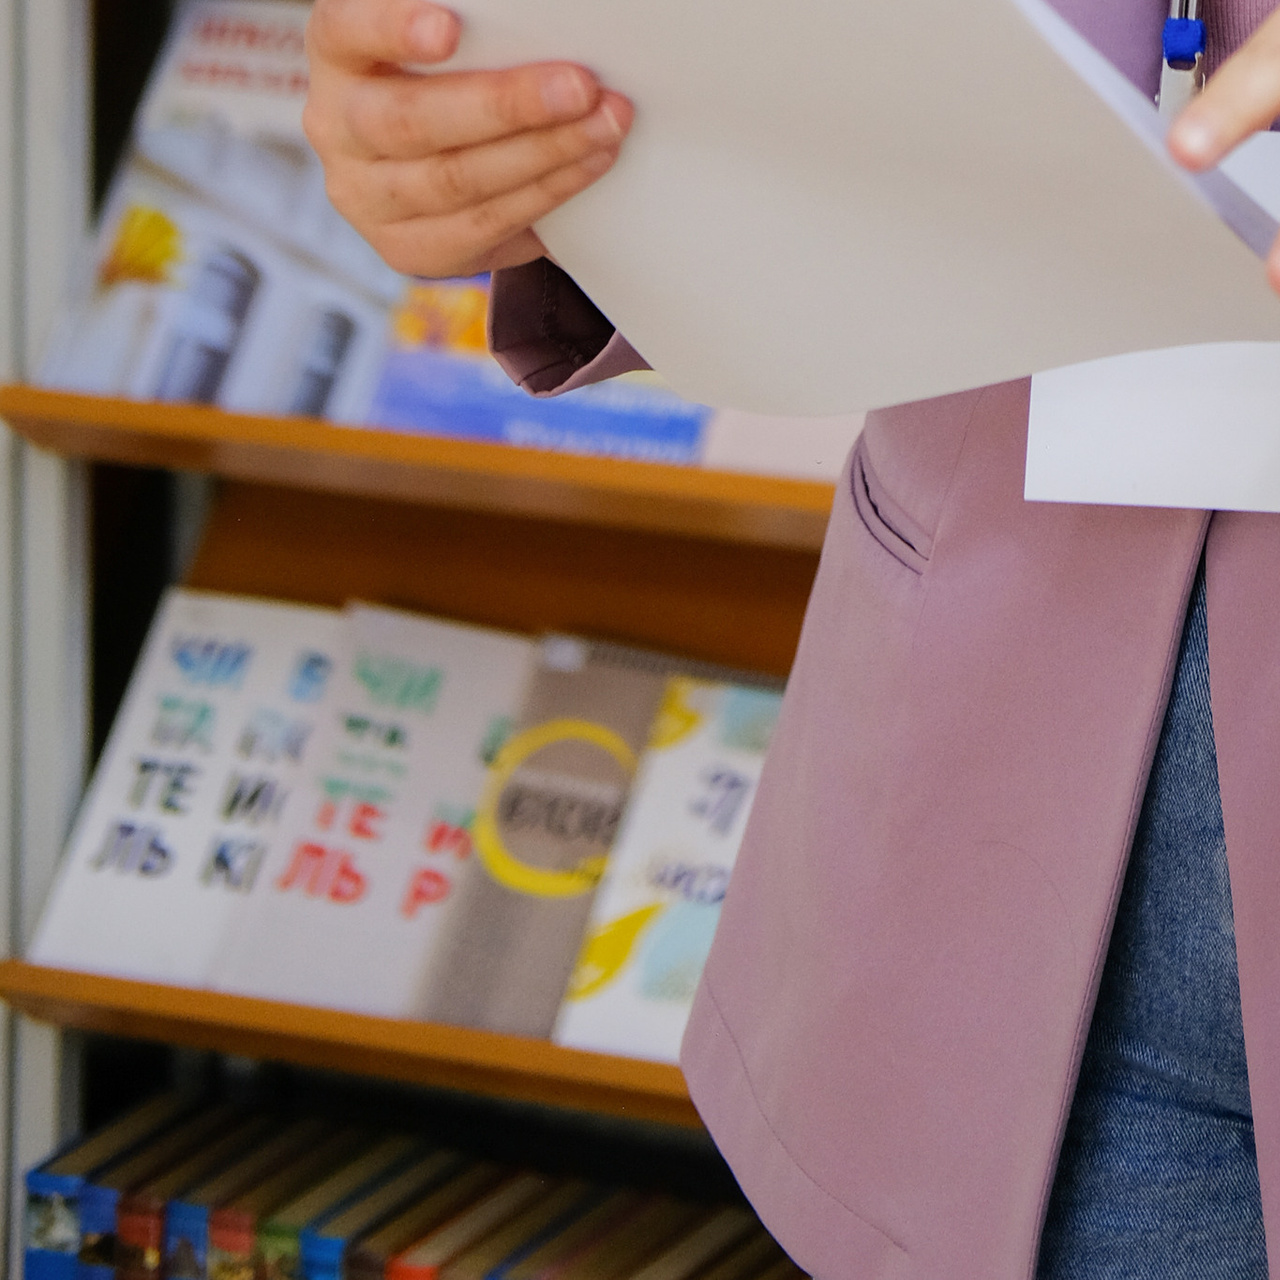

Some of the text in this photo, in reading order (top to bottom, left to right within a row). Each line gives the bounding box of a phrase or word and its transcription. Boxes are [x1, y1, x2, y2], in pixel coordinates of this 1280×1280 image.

[171, 632, 256, 691] ЧИ
[354, 656, 446, 715] ЧИ
[126, 756, 204, 815] ТЕ
[314, 776, 396, 844] ТЕ
[89, 820, 175, 880] ЛЬ
[274, 840, 372, 905] ЛЬ
